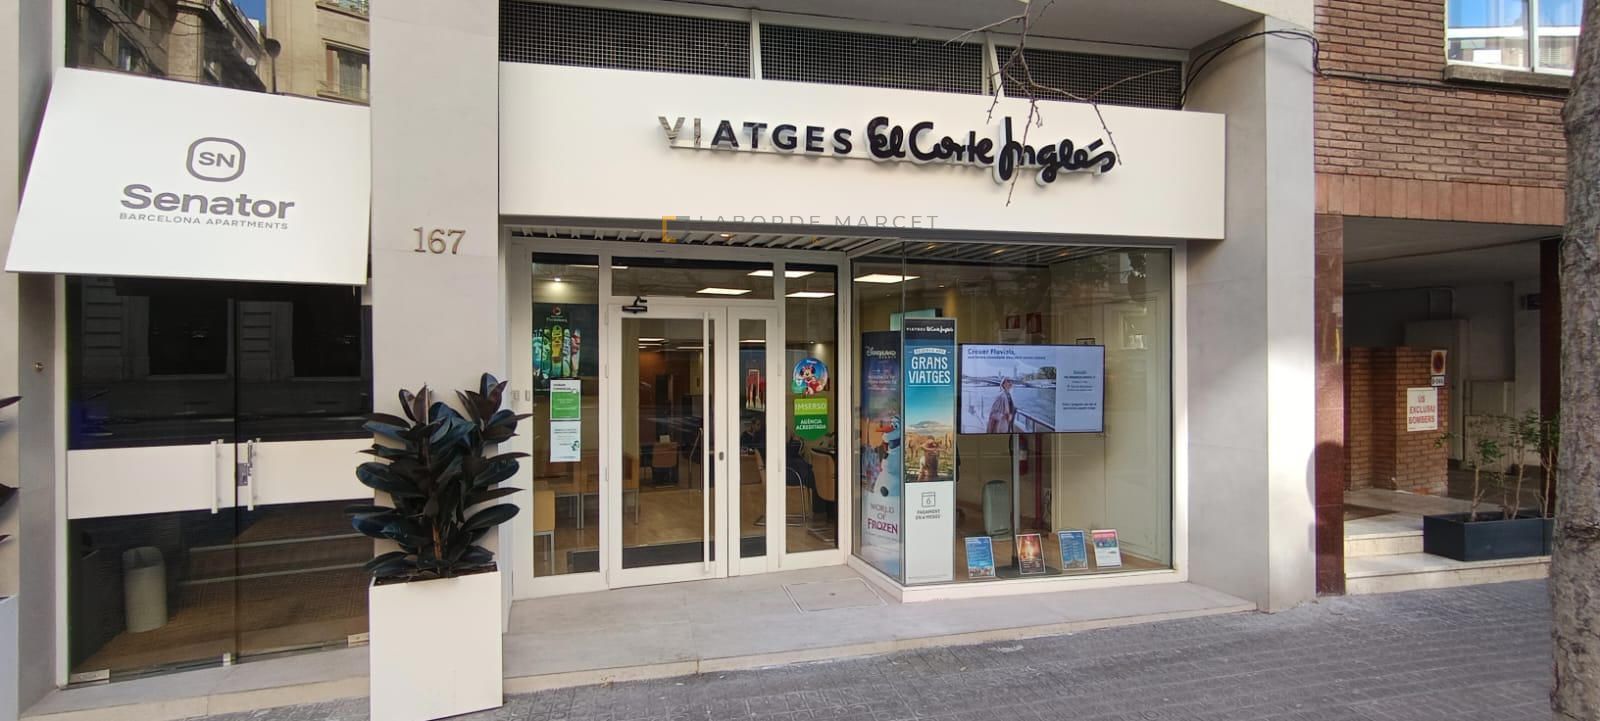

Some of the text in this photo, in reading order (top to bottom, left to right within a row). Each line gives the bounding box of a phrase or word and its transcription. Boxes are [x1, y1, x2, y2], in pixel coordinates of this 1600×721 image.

[658, 115, 853, 154] VIATGES
[867, 116, 905, 161] El
[908, 121, 994, 165] Corte
[198, 152, 236, 169] SN
[120, 183, 295, 219] Senator
[119, 213, 289, 230] BARCELONA APARTMENTS
[413, 226, 467, 255] 167
[911, 356, 948, 370] GRANS
[908, 370, 951, 384] VIATGES
[795, 402, 827, 410] IMSERSO
[1408, 415, 1435, 424] BOMBERS
[870, 503, 895, 513] WORLD
[876, 512, 886, 520] OF
[867, 517, 898, 535] FROZEN
